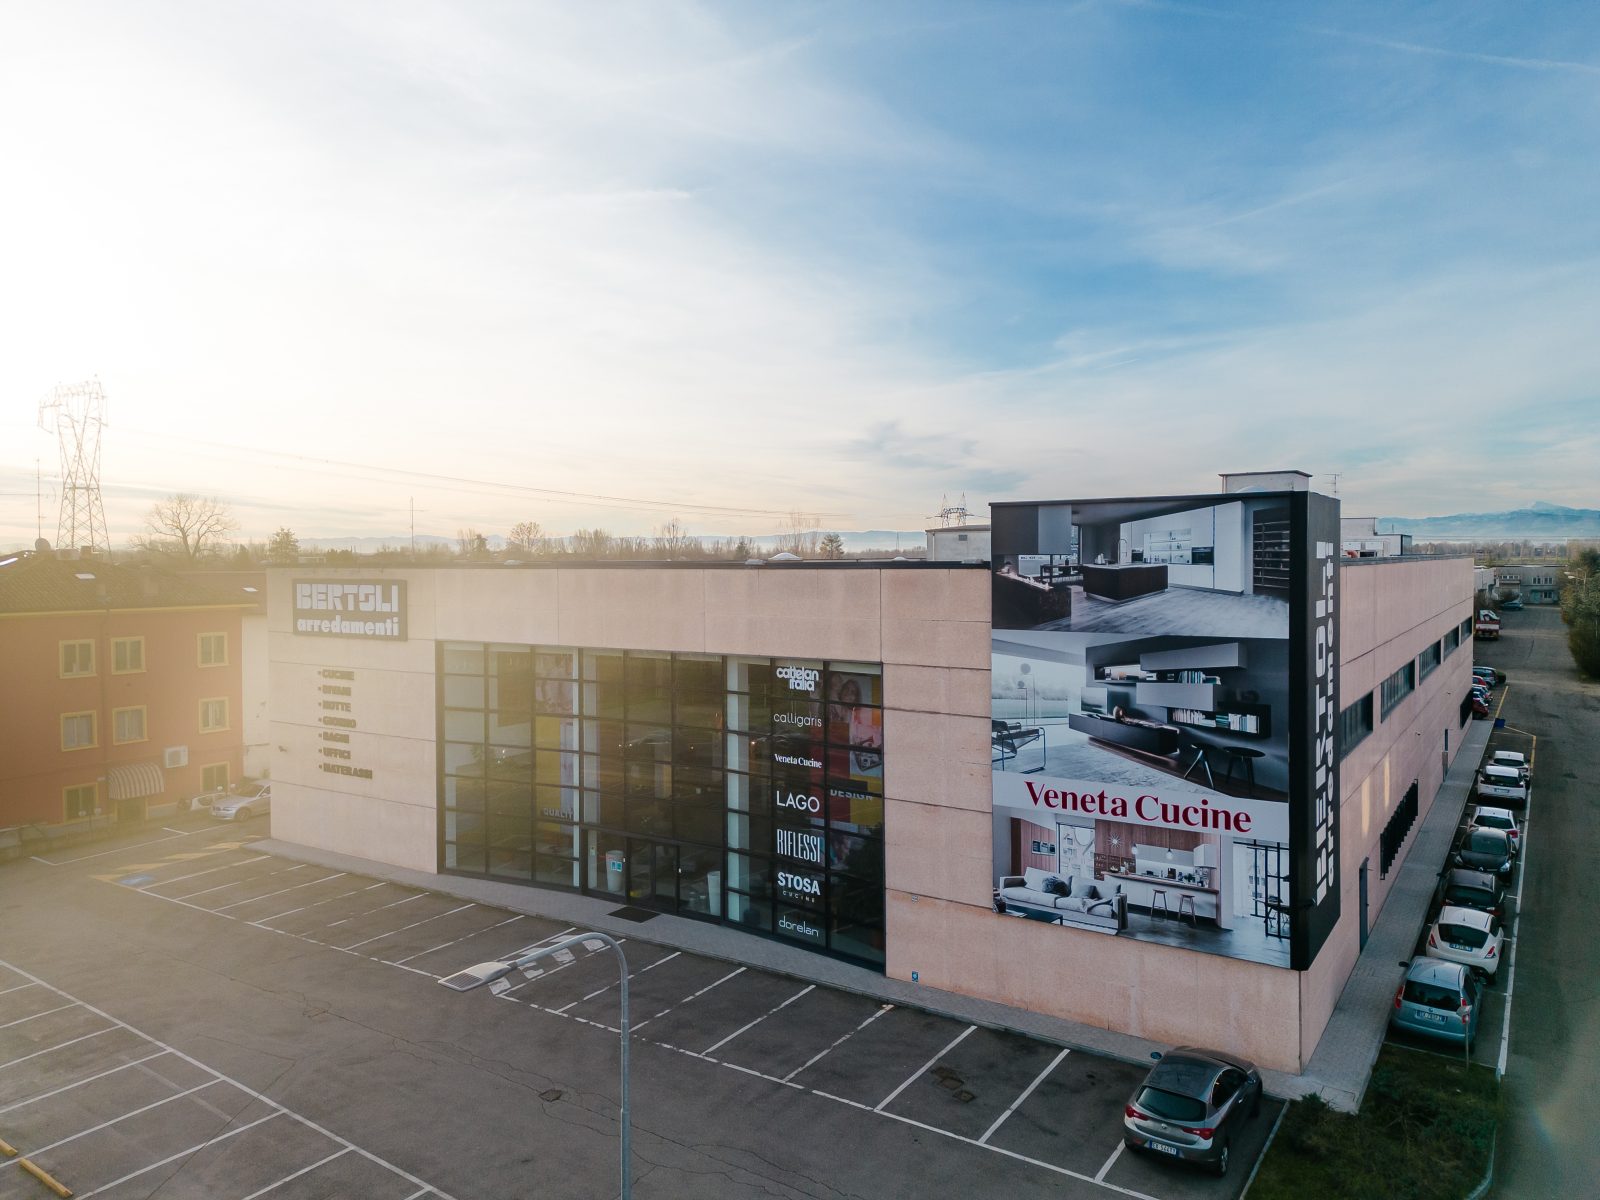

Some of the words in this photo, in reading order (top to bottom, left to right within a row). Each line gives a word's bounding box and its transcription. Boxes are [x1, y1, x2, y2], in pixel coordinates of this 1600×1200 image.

[296, 583, 399, 612] BERTOLI
[296, 615, 399, 636] arredamenti
[773, 713, 822, 727] calligaris
[774, 753, 799, 765] Veneta
[798, 757, 822, 768] Cucine
[776, 790, 820, 812] LAGO
[1024, 781, 1128, 818] Veneta
[1135, 795, 1252, 833] Cucine
[776, 829, 821, 863] RIFLESSI
[777, 871, 821, 895] STOSA
[778, 915, 819, 937] dorelan
